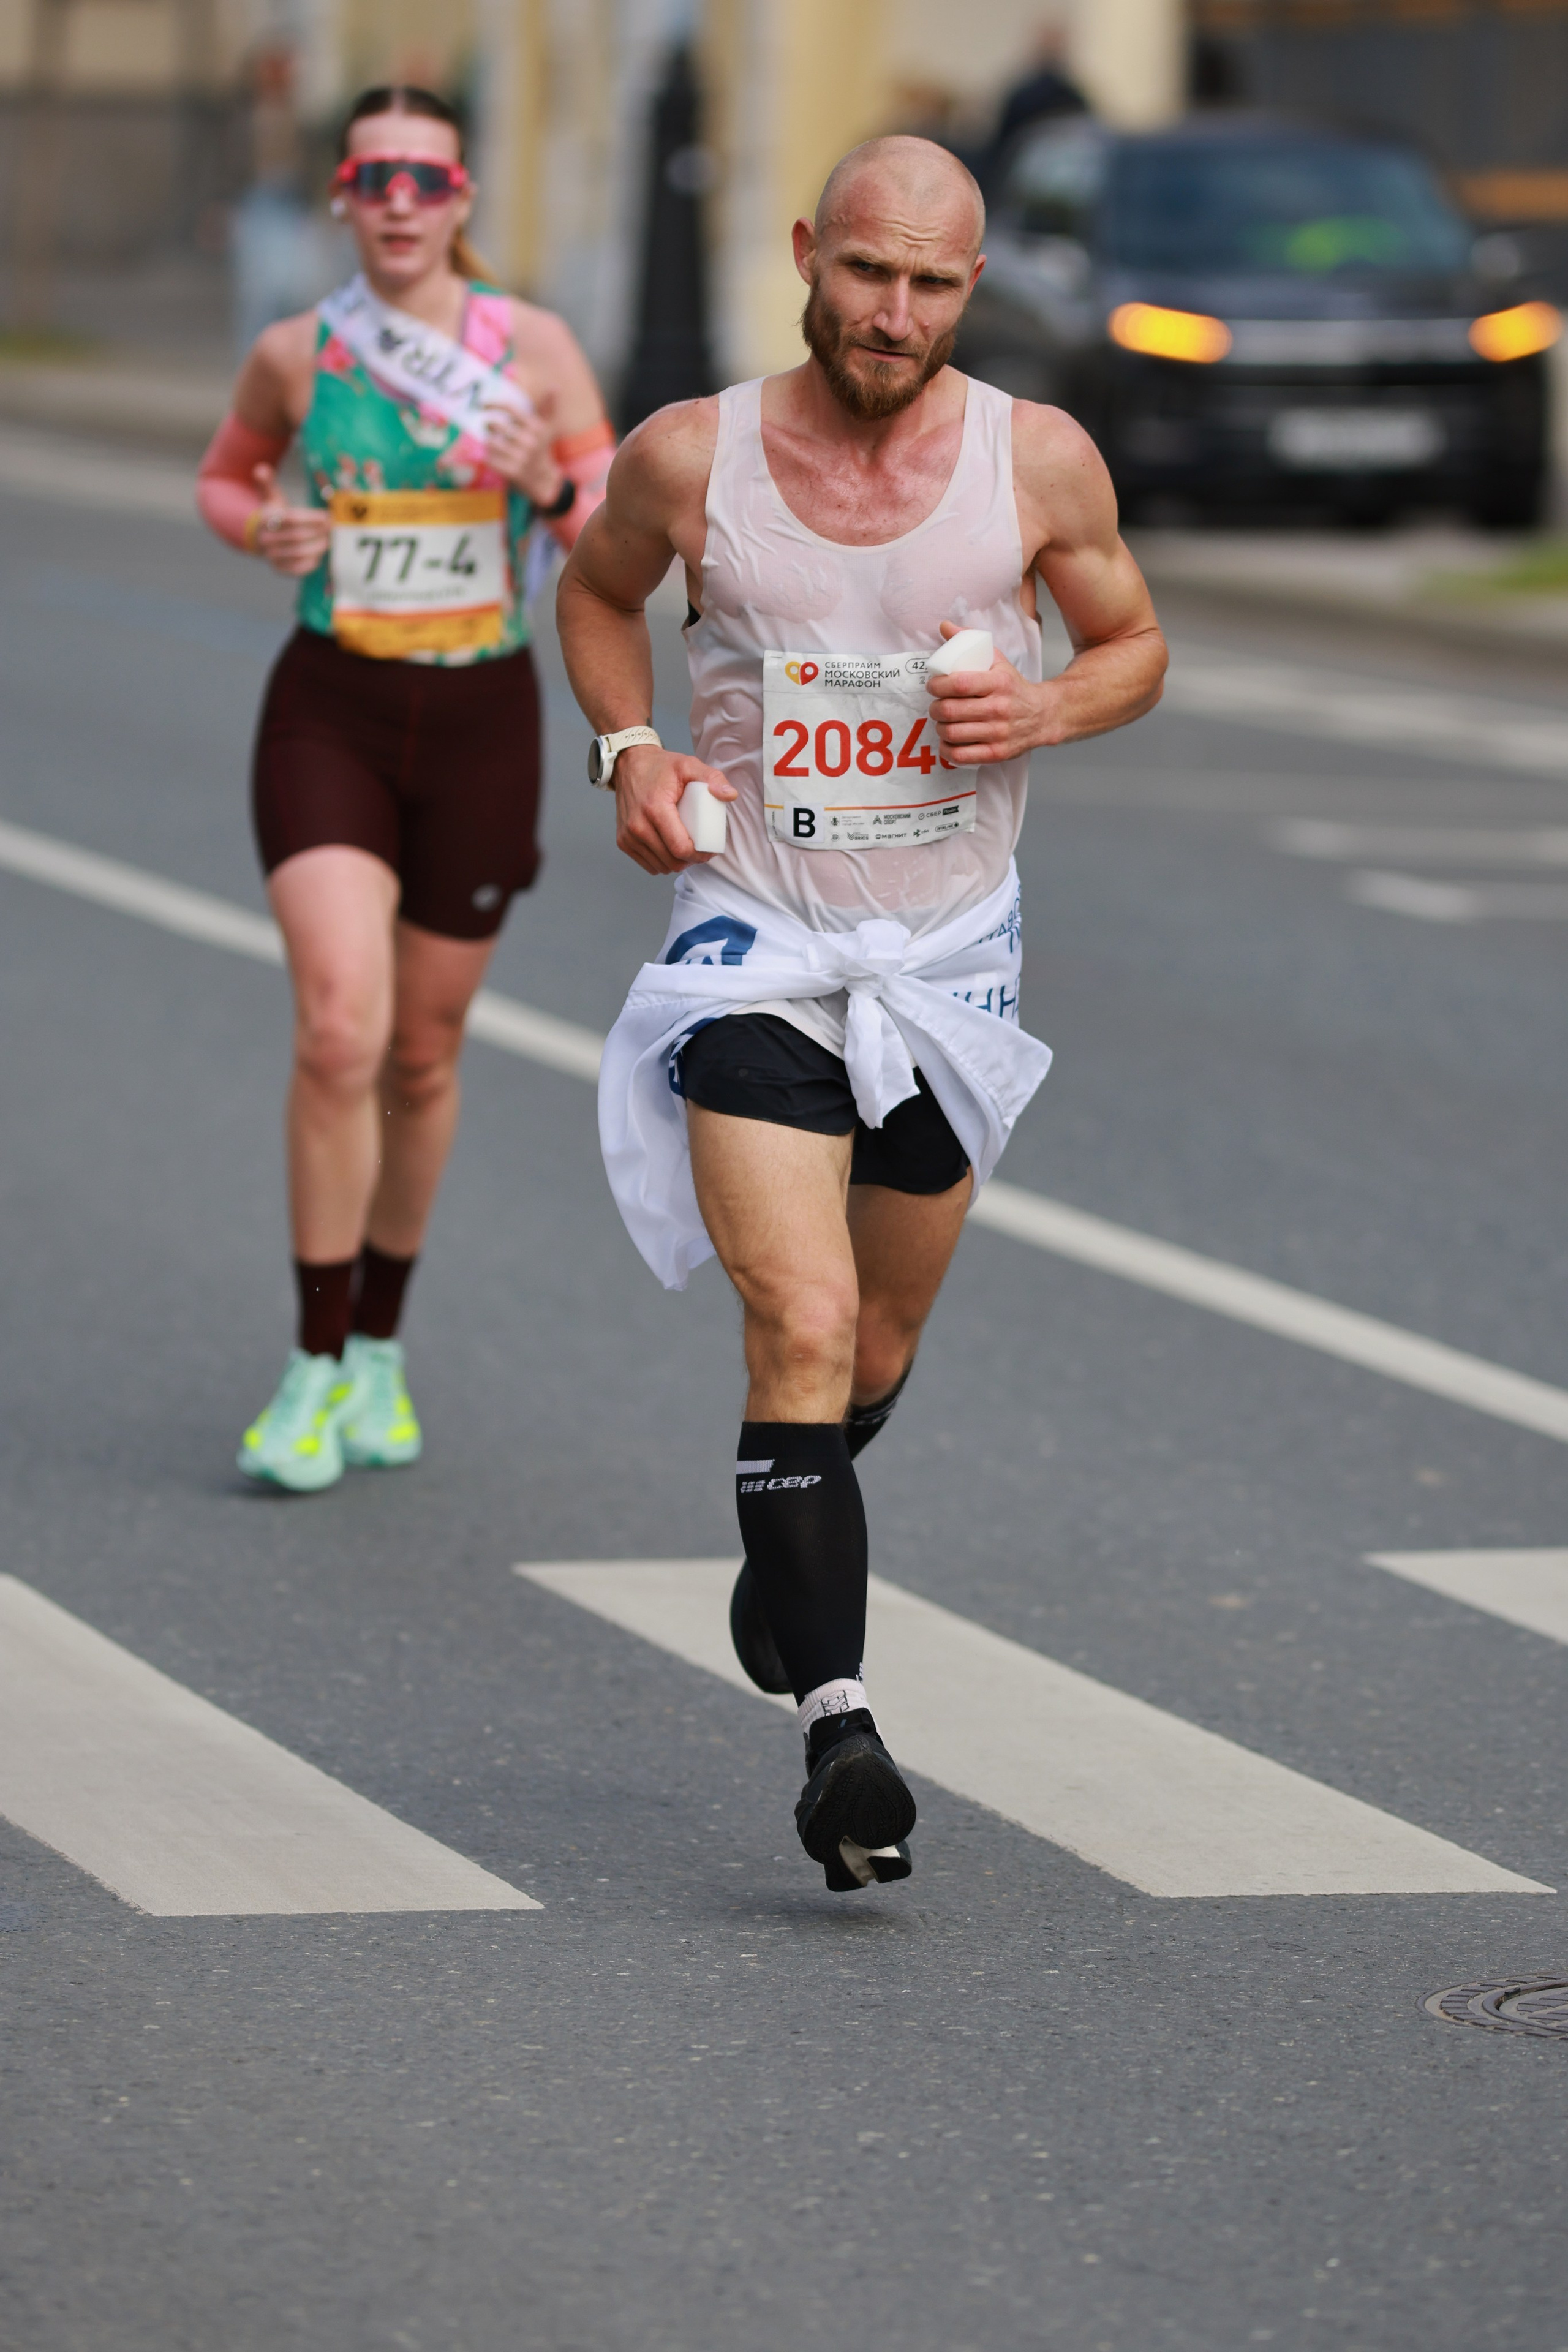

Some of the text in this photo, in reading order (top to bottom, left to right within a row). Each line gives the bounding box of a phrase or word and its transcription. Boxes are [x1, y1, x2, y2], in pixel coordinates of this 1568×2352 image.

[358, 534, 476, 581] 77-4
[911, 661, 928, 671] 42,
[824, 668, 900, 679] МОСКОВСКИЙ
[824, 679, 881, 688] МАРАФОН
[772, 717, 957, 777] 2084
